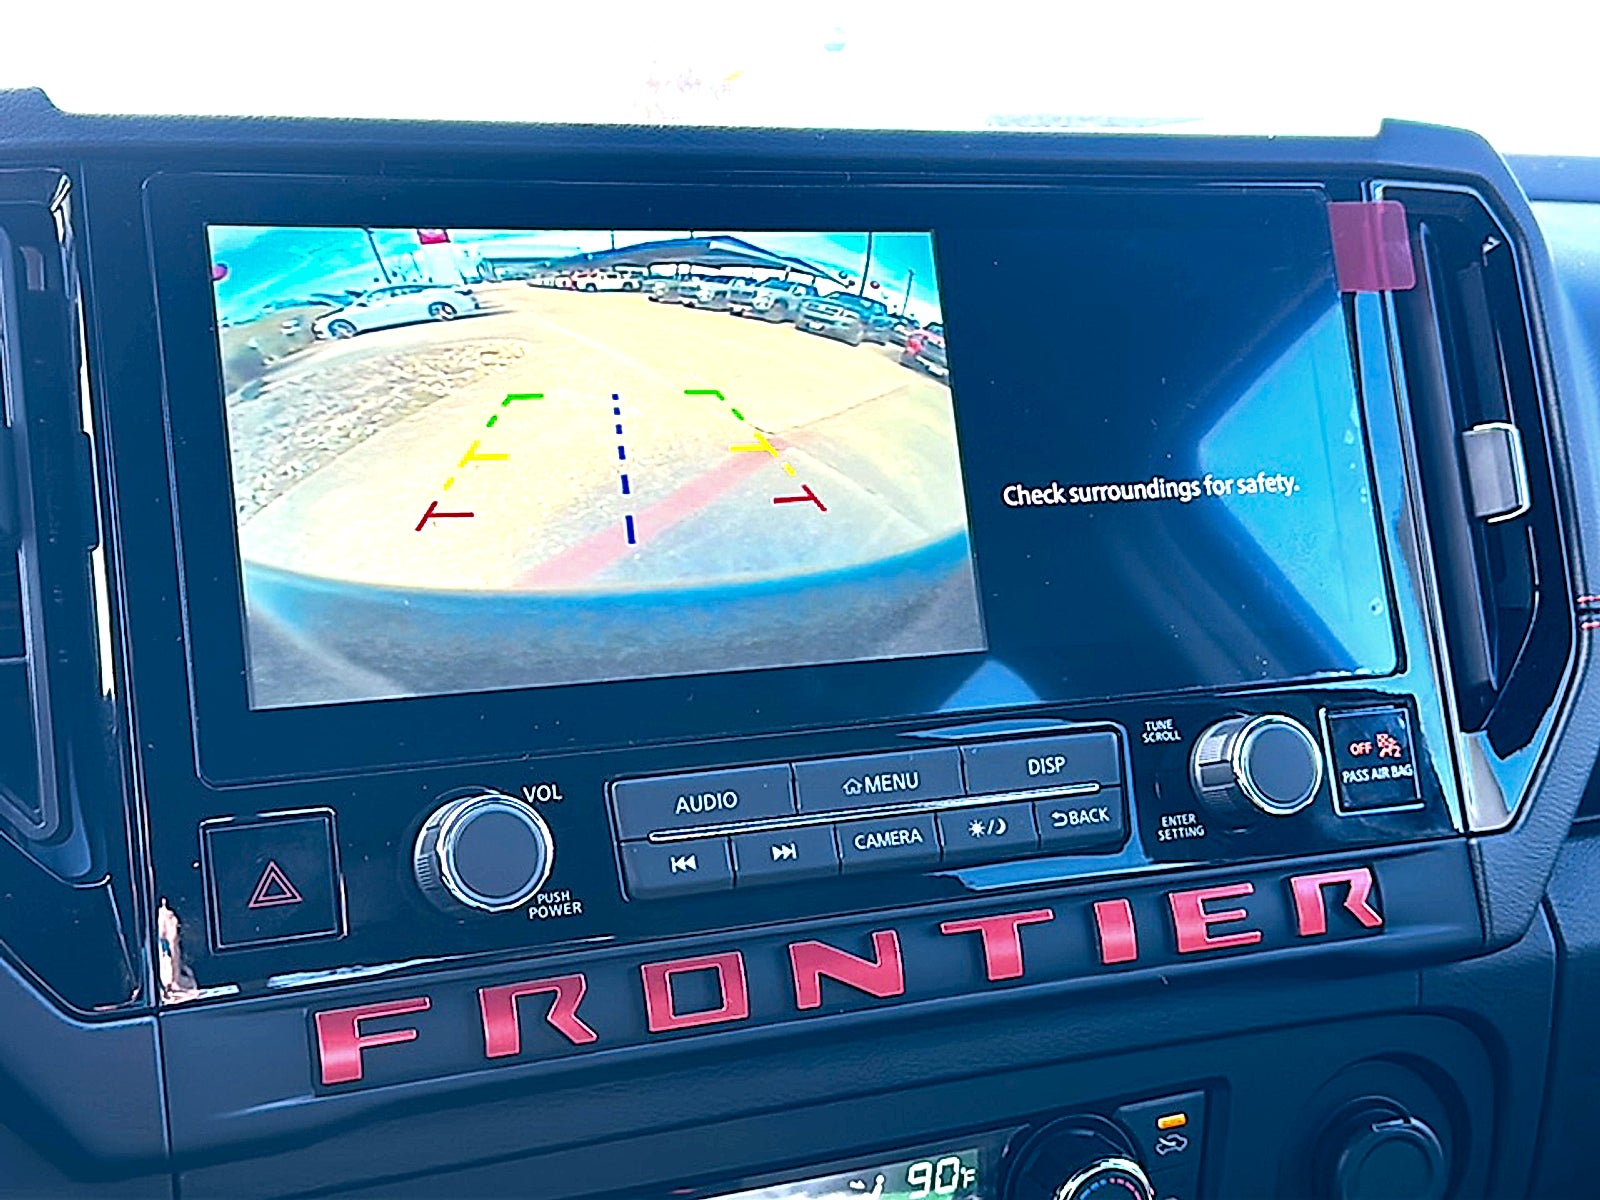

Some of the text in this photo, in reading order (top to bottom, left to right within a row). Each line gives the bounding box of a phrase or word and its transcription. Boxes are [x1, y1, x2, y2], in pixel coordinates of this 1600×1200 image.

[1003, 471, 1300, 507] Check surroundings for safety.
[1144, 719, 1174, 732] TUNE
[1141, 730, 1182, 744] SCROLL
[1349, 741, 1373, 756] OFF
[1028, 755, 1066, 776] DISP
[1341, 763, 1413, 784] PASS AIR BAG
[523, 783, 563, 803] VOL
[864, 772, 919, 795] MENU
[674, 790, 738, 816] AUDIO
[1069, 806, 1110, 826] BACK
[1161, 813, 1197, 828] ENTER
[854, 827, 924, 851] CAMERA
[1157, 825, 1205, 842] SETTING
[537, 889, 571, 905] PUSH
[528, 901, 583, 920] POWER
[314, 866, 1384, 1085] FRONTIER
